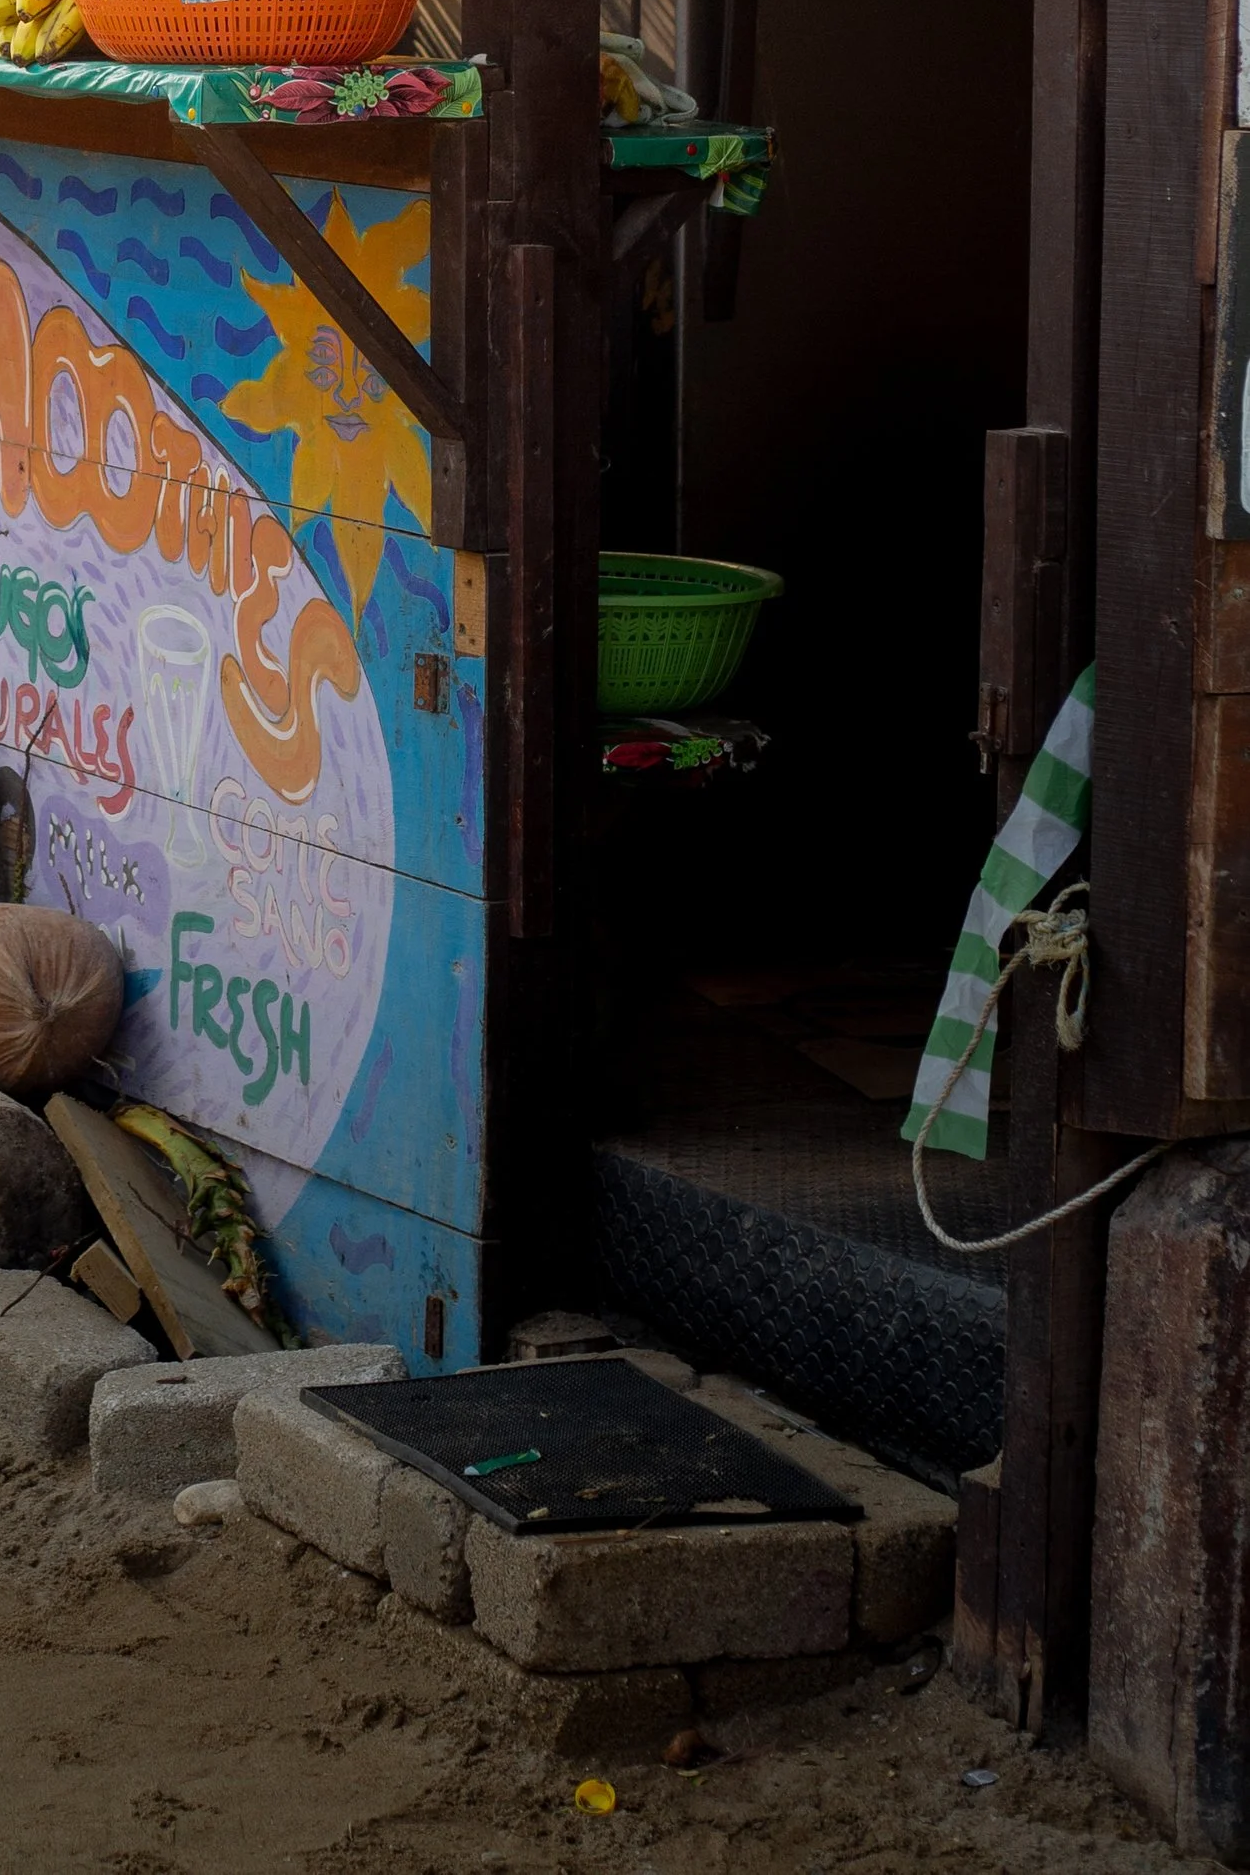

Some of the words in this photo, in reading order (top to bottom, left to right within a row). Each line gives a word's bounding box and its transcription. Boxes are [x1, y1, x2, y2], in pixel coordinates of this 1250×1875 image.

[48, 811, 146, 906] MILK
[208, 776, 354, 918] COME
[228, 866, 352, 980] SANO
[170, 911, 311, 1106] FRESH
